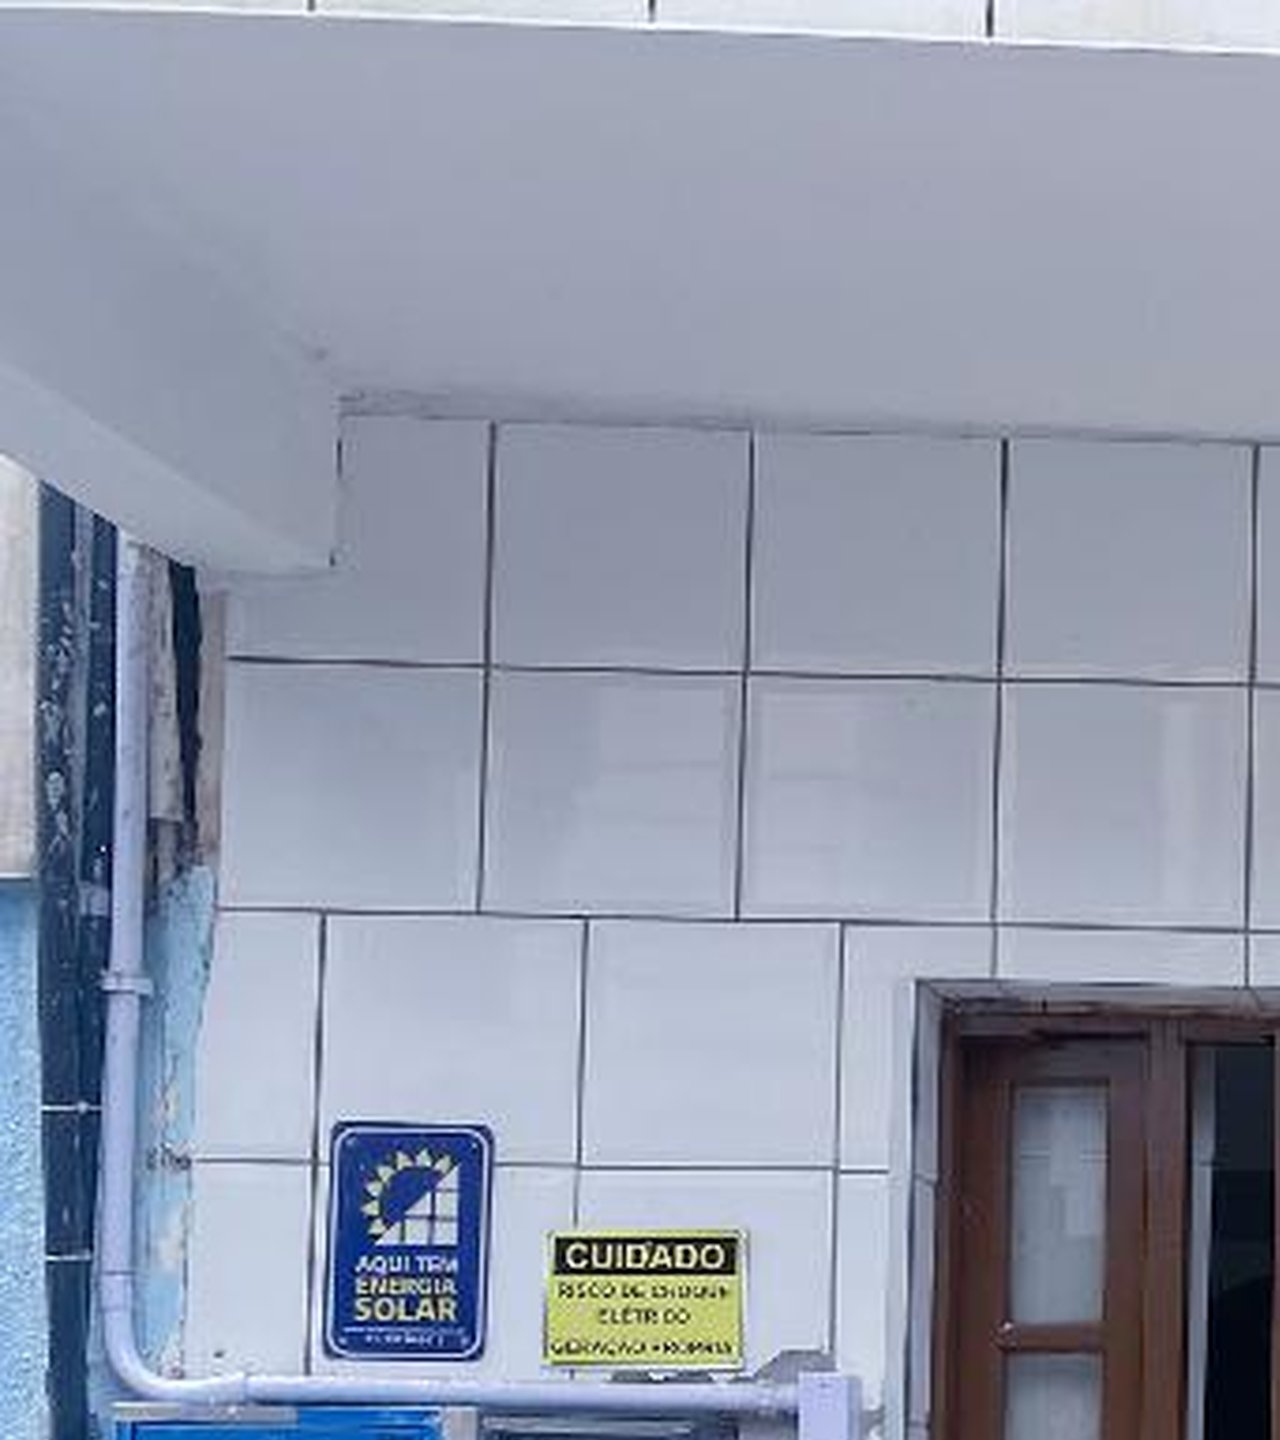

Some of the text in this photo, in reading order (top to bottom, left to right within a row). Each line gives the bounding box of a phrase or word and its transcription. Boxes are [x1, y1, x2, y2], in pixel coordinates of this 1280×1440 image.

[355, 1254, 459, 1275] AQUI TEM
[565, 1242, 726, 1270] CUIDADO
[355, 1277, 458, 1295] ENERGIA
[354, 1297, 458, 1321] SOLAR
